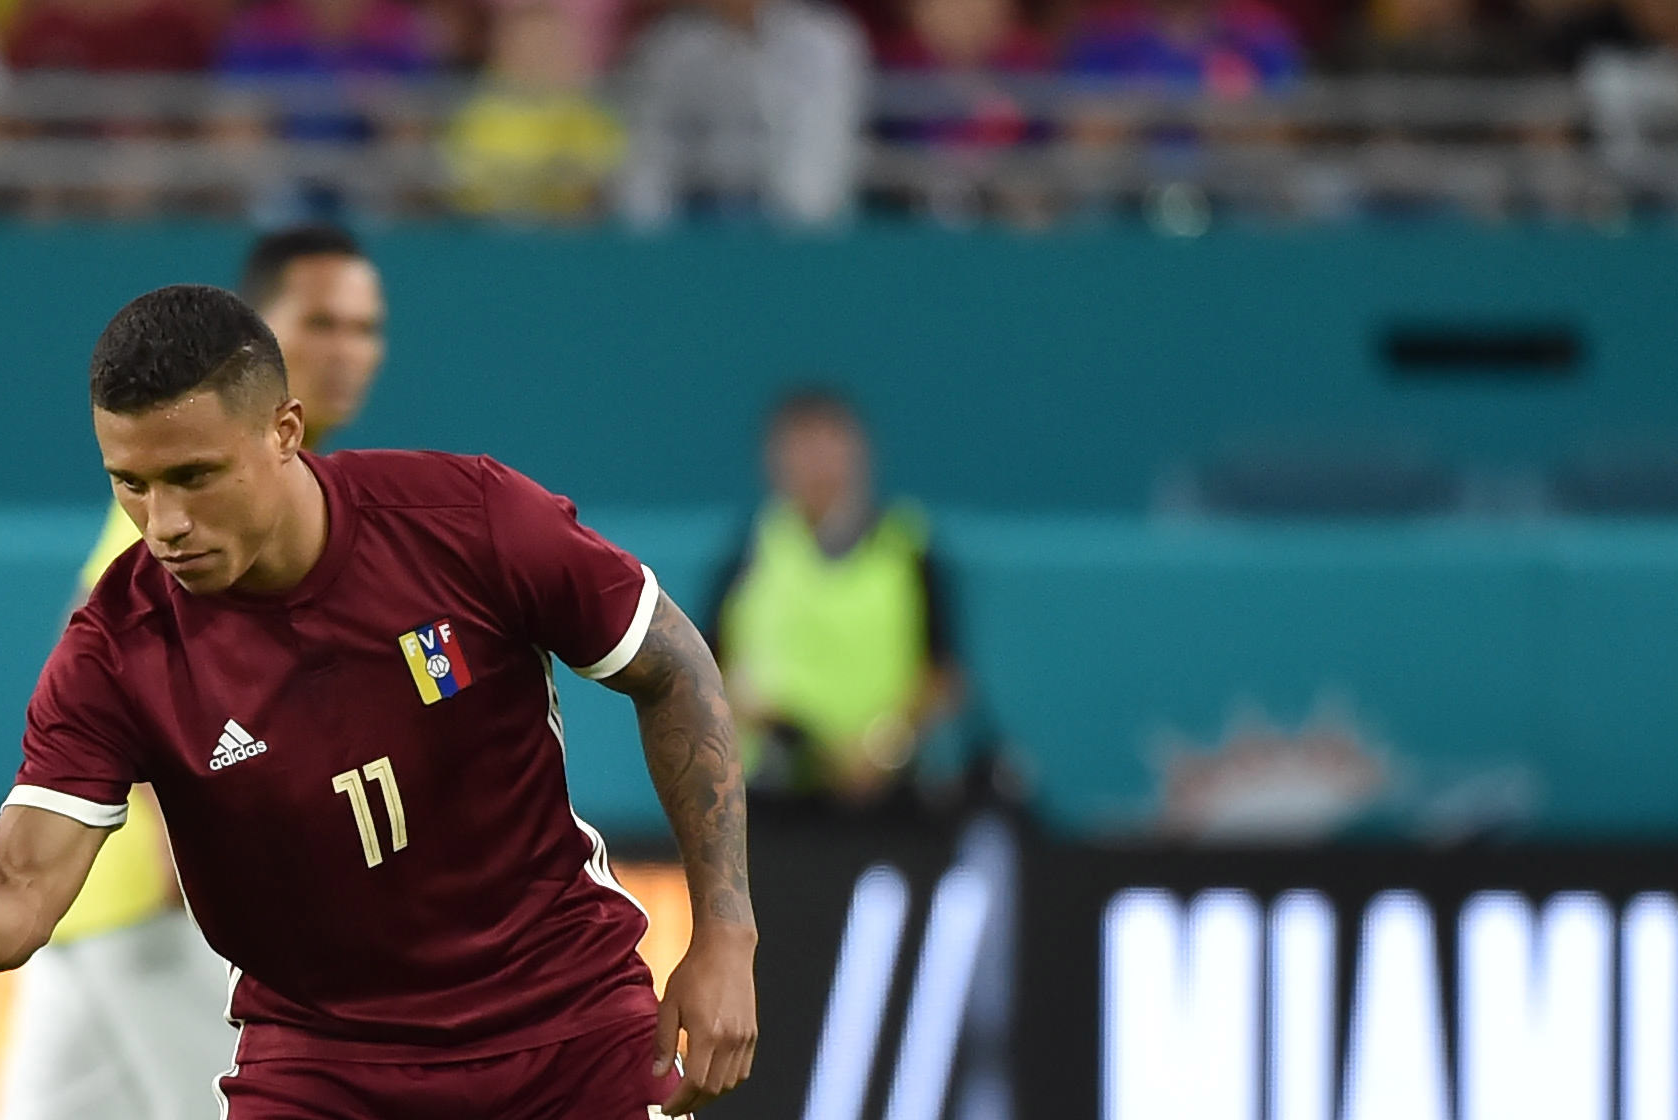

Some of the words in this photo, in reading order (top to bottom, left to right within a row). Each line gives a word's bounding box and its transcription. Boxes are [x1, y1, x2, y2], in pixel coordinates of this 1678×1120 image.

[404, 623, 452, 657] FVF
[209, 740, 268, 771] adidas
[331, 756, 408, 869] 11
